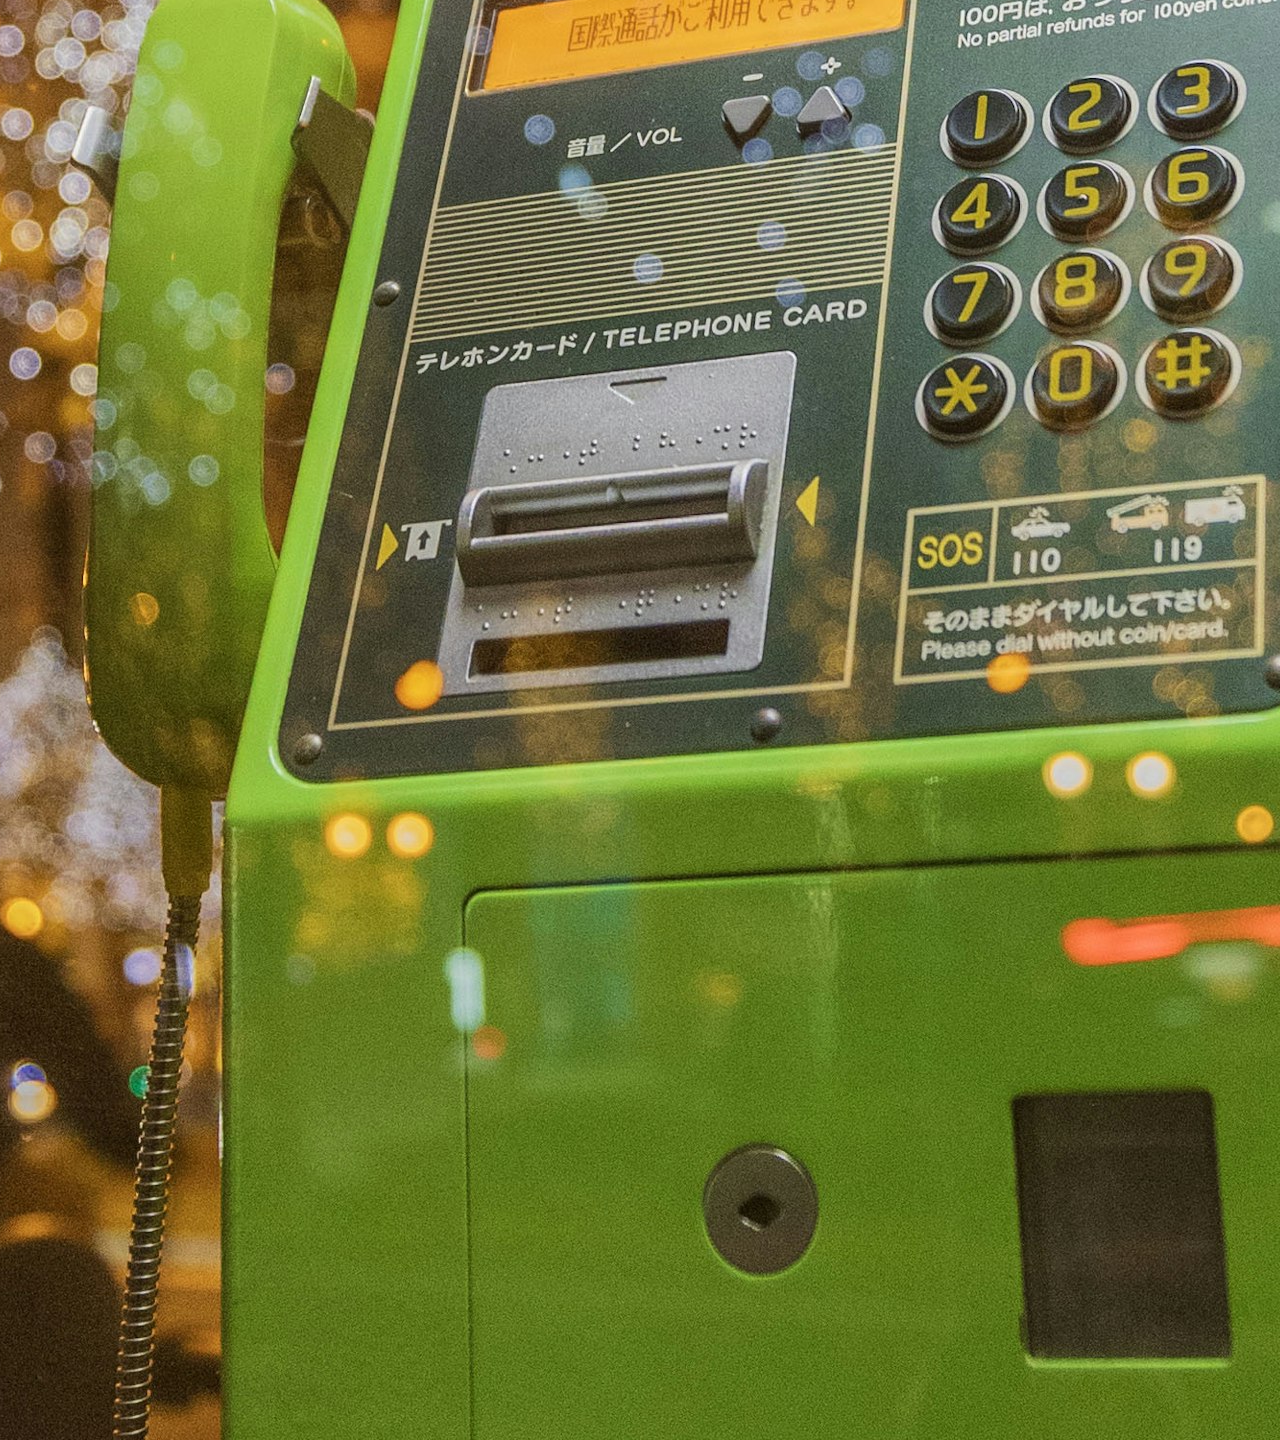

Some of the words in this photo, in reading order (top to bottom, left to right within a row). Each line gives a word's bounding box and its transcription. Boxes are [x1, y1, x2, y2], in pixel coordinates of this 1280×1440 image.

[957, 31, 983, 49] No
[987, 20, 1043, 47] partial
[1046, 8, 1116, 37] refunds
[1120, 6, 1147, 24] for
[1068, 81, 1102, 132] 2
[1176, 66, 1211, 115] 3
[566, 133, 607, 160] 音量
[636, 126, 683, 150] VOL
[974, 95, 989, 141] 1
[1063, 166, 1100, 217] 5
[1167, 152, 1210, 203] 6
[950, 182, 991, 230] 4
[1054, 256, 1098, 308] 8
[1164, 245, 1208, 297] 9
[953, 271, 989, 322] 7
[415, 333, 578, 374] テレホンカード
[604, 310, 773, 350] TELEPHONE
[783, 298, 868, 327] CARD
[1048, 347, 1093, 403] 0
[917, 531, 983, 570] SOS
[1013, 547, 1062, 575] 110
[1154, 535, 1204, 564] 119
[923, 588, 1232, 634] そのままダイヤルして下さい。
[921, 637, 992, 662] Please
[995, 631, 1033, 656] dial
[1036, 624, 1116, 652] without
[1119, 617, 1229, 645] coin/card.
